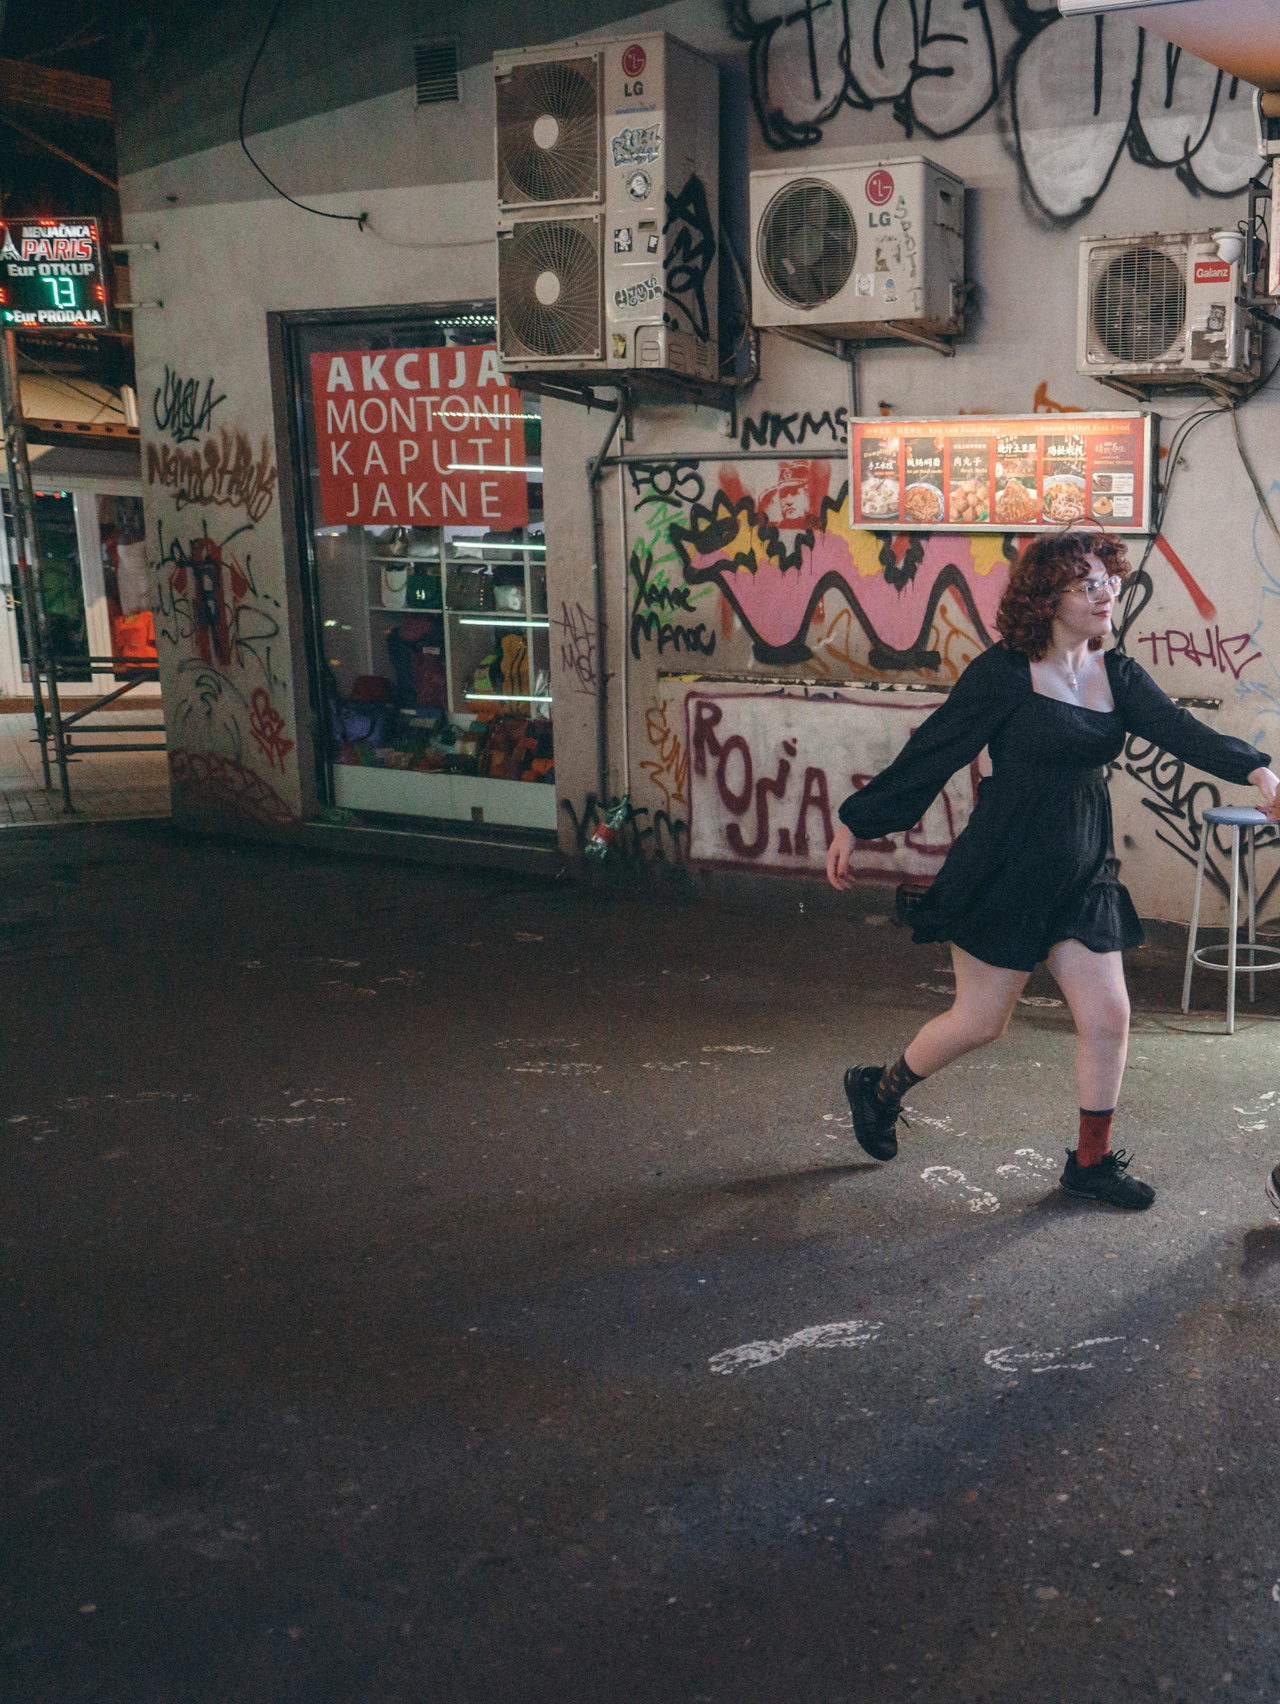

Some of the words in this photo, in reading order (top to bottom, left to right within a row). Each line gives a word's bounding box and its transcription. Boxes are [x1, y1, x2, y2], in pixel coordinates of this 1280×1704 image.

[624, 82, 644, 97] LG
[868, 211, 891, 229] LG
[21, 238, 92, 262] PARIS
[7, 264, 37, 277] Eur
[38, 263, 95, 276] OTKUP
[1196, 266, 1229, 279] Galanz
[14, 311, 37, 323] Eur
[38, 310, 102, 323] PRODAJA
[326, 350, 508, 393] AKCIJA
[327, 394, 511, 435] MONTONI
[961, 425, 1001, 435] Dumplings
[1035, 424, 1066, 433] Chinese
[1067, 424, 1091, 433] Street
[1093, 424, 1109, 432] Fast
[1111, 423, 1130, 432] Food
[330, 438, 511, 476] KAPUTI
[953, 456, 982, 467] 肉丸子
[346, 482, 502, 518] JAKNE
